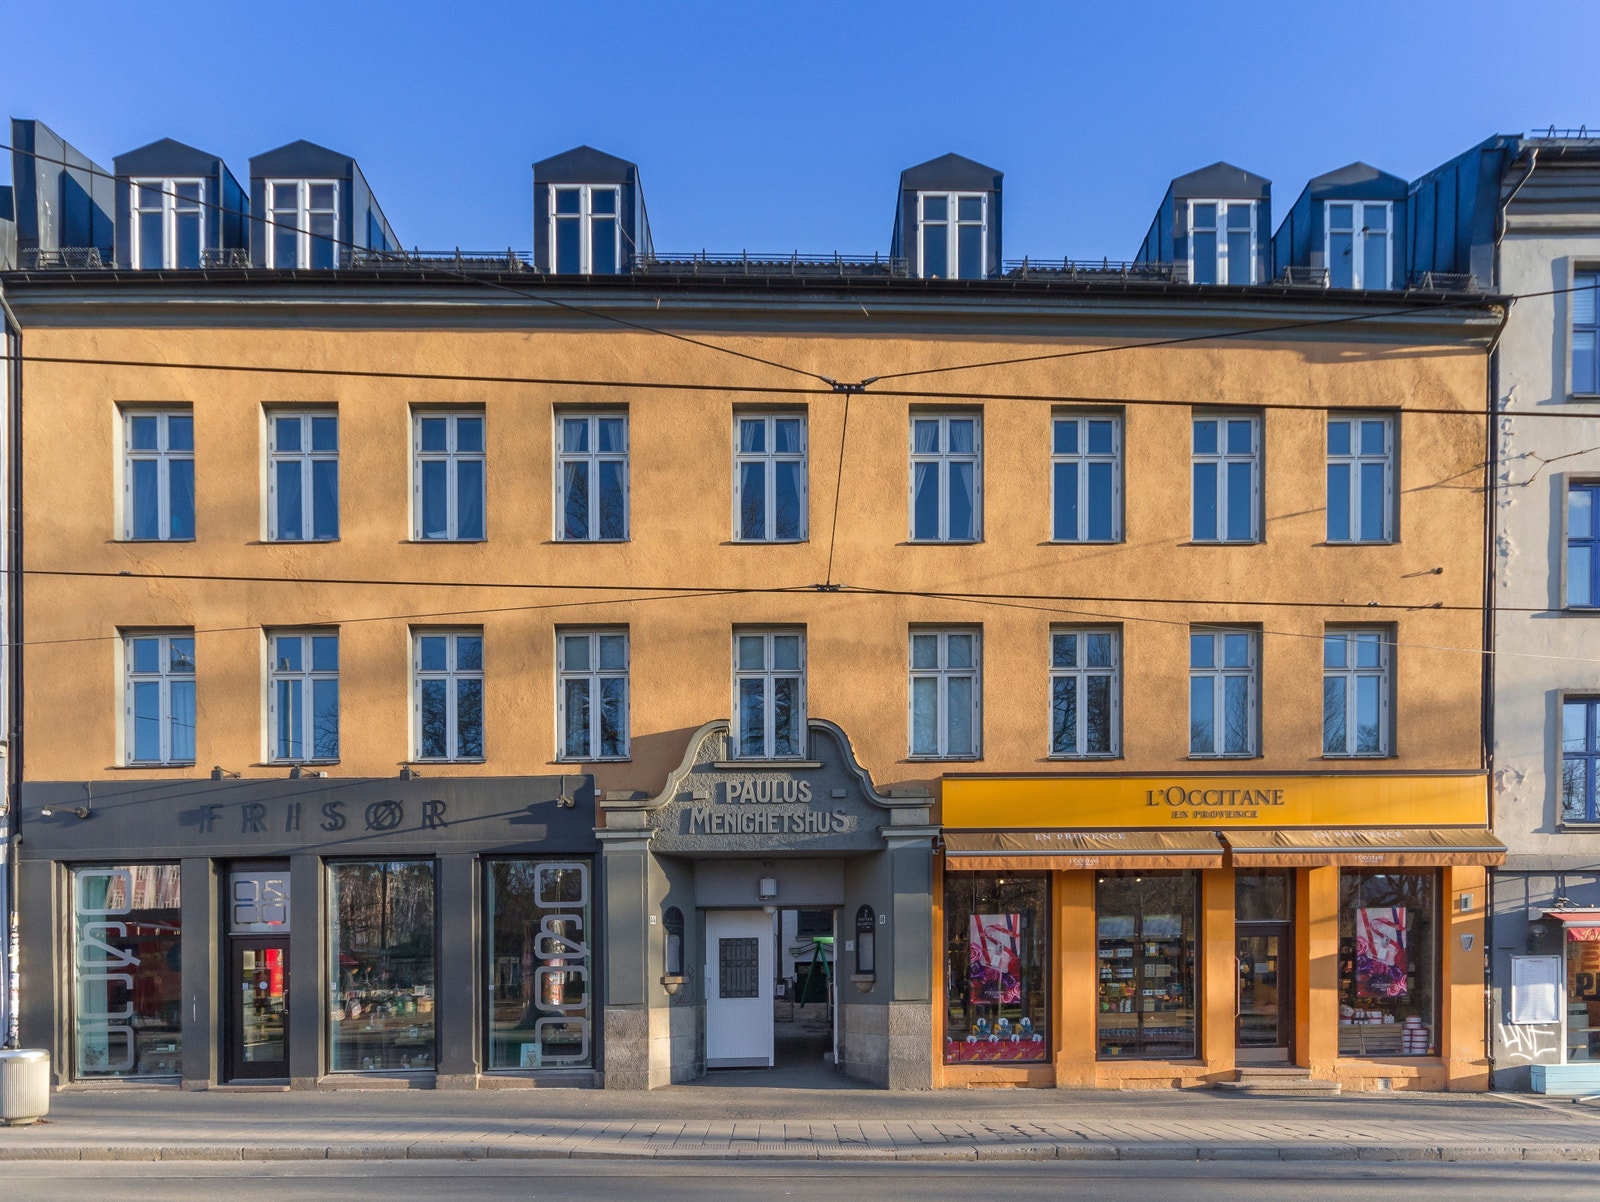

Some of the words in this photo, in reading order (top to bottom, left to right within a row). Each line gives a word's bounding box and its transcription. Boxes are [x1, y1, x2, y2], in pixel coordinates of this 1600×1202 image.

[726, 780, 812, 804] PAULUS
[1146, 786, 1285, 807] L'OCCITANE
[202, 800, 449, 834] FRISØR
[689, 807, 849, 834] MENIGHETSHUS
[1172, 811, 1189, 819] EN
[1193, 811, 1258, 819] PROVENCE
[1034, 832, 1051, 840] EN
[1057, 832, 1126, 840] PROVENCE
[1313, 831, 1331, 839] EN
